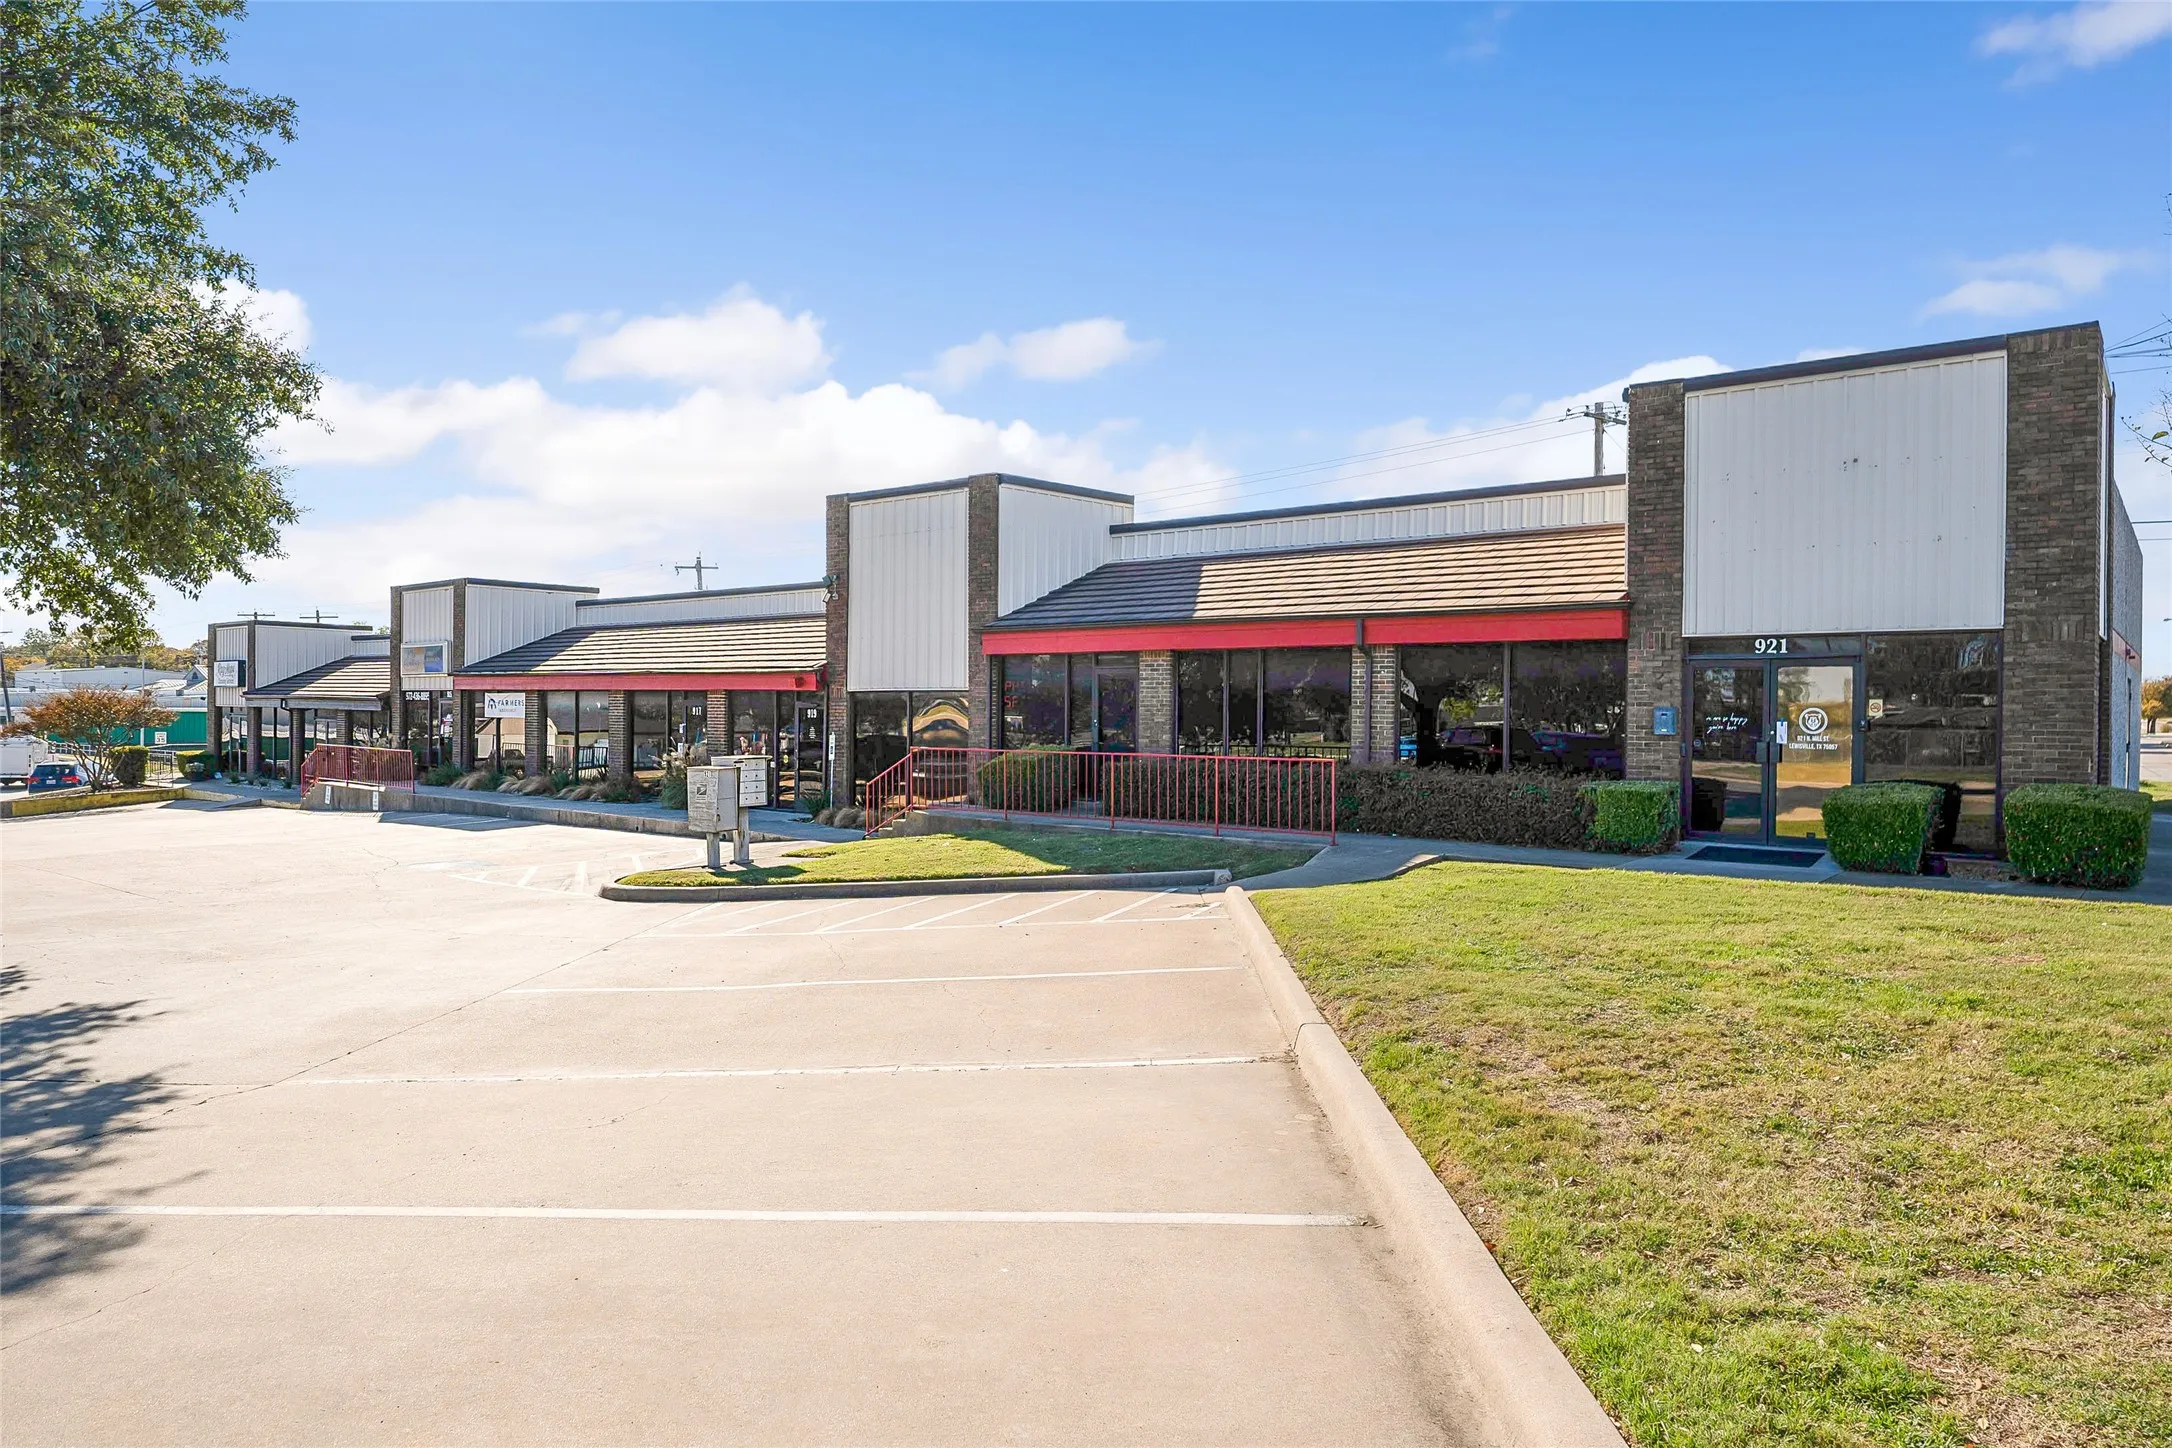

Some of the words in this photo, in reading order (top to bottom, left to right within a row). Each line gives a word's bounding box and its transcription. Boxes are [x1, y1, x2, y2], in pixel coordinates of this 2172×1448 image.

[1754, 638, 1788, 654] 921
[692, 706, 702, 715] 917
[807, 708, 817, 718] 919
[1729, 712, 1748, 726] happy
